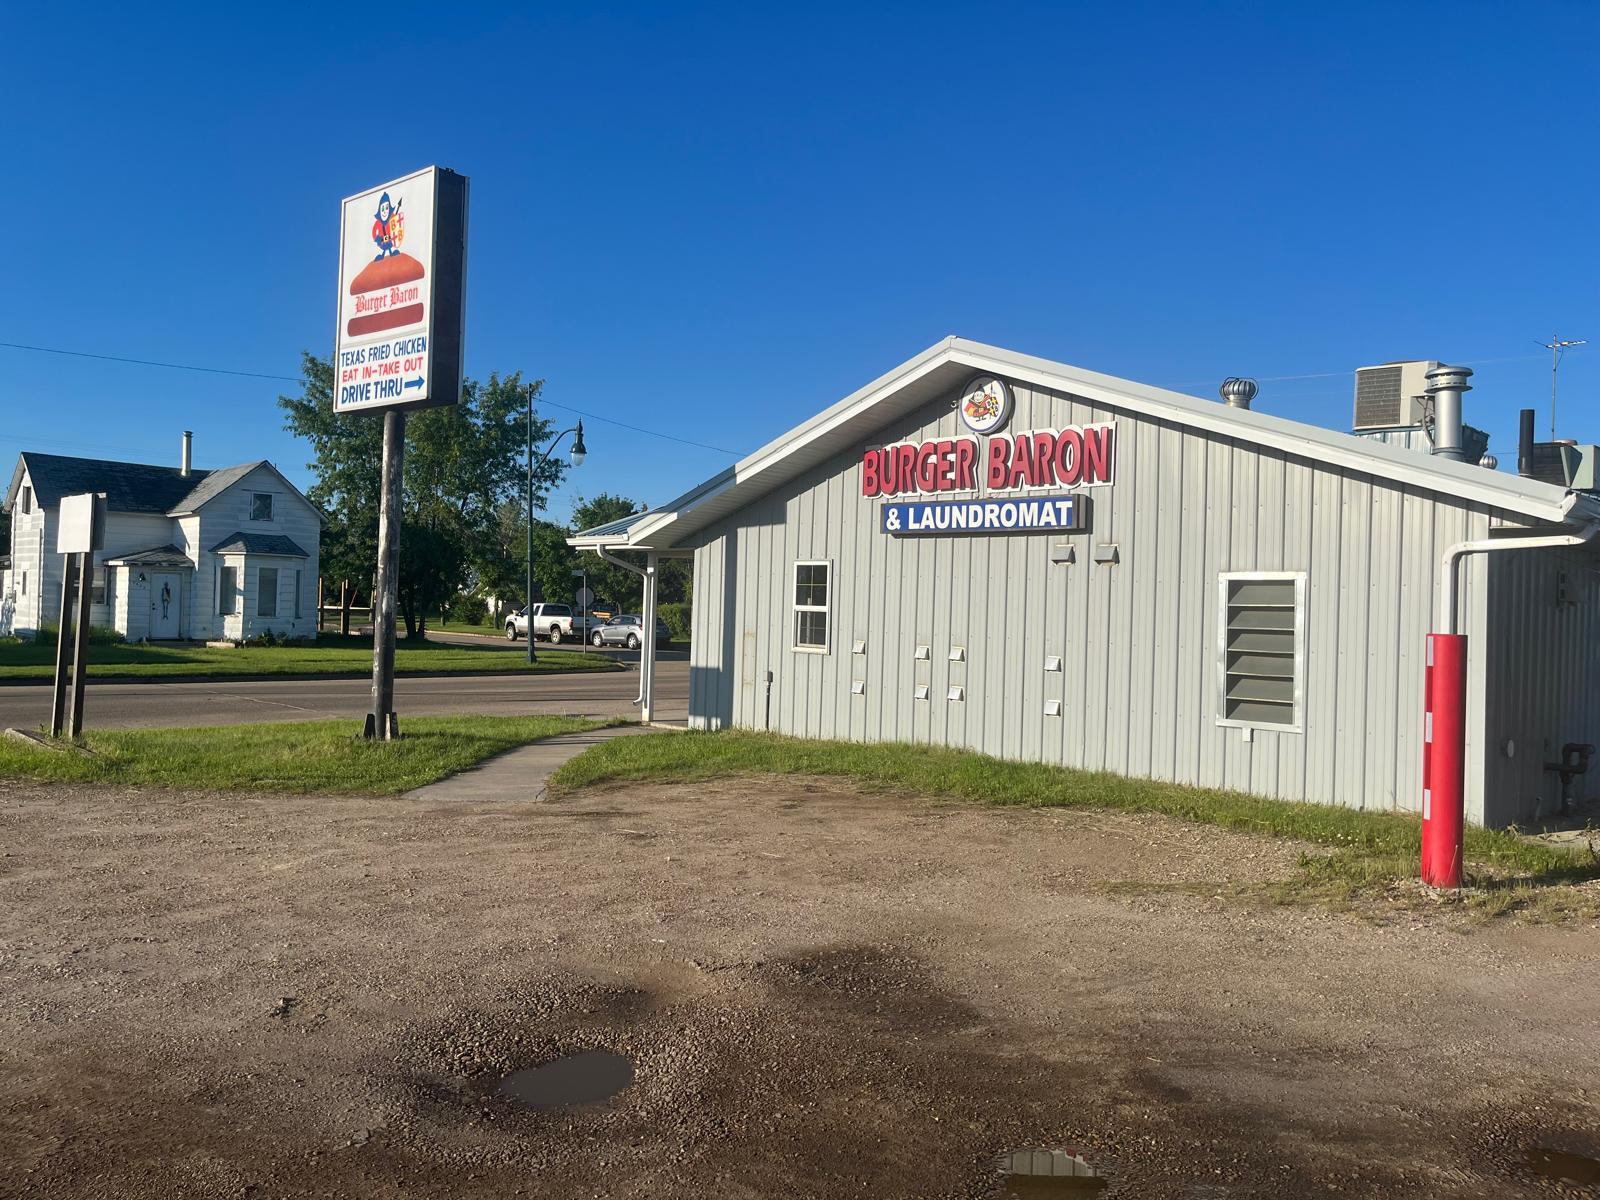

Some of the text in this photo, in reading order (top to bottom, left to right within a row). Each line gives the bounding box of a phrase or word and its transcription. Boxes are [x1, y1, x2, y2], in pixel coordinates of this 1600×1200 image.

[355, 286, 419, 314] Burger Baron
[341, 336, 427, 367] TEXAS FRIED CHICKEN
[342, 356, 424, 382] EAT IN-TAKE OUT
[341, 377, 403, 404] DRIVE THRU
[863, 426, 1111, 497] BURGER BARON
[886, 500, 1073, 531] & LAUNDROMAT
